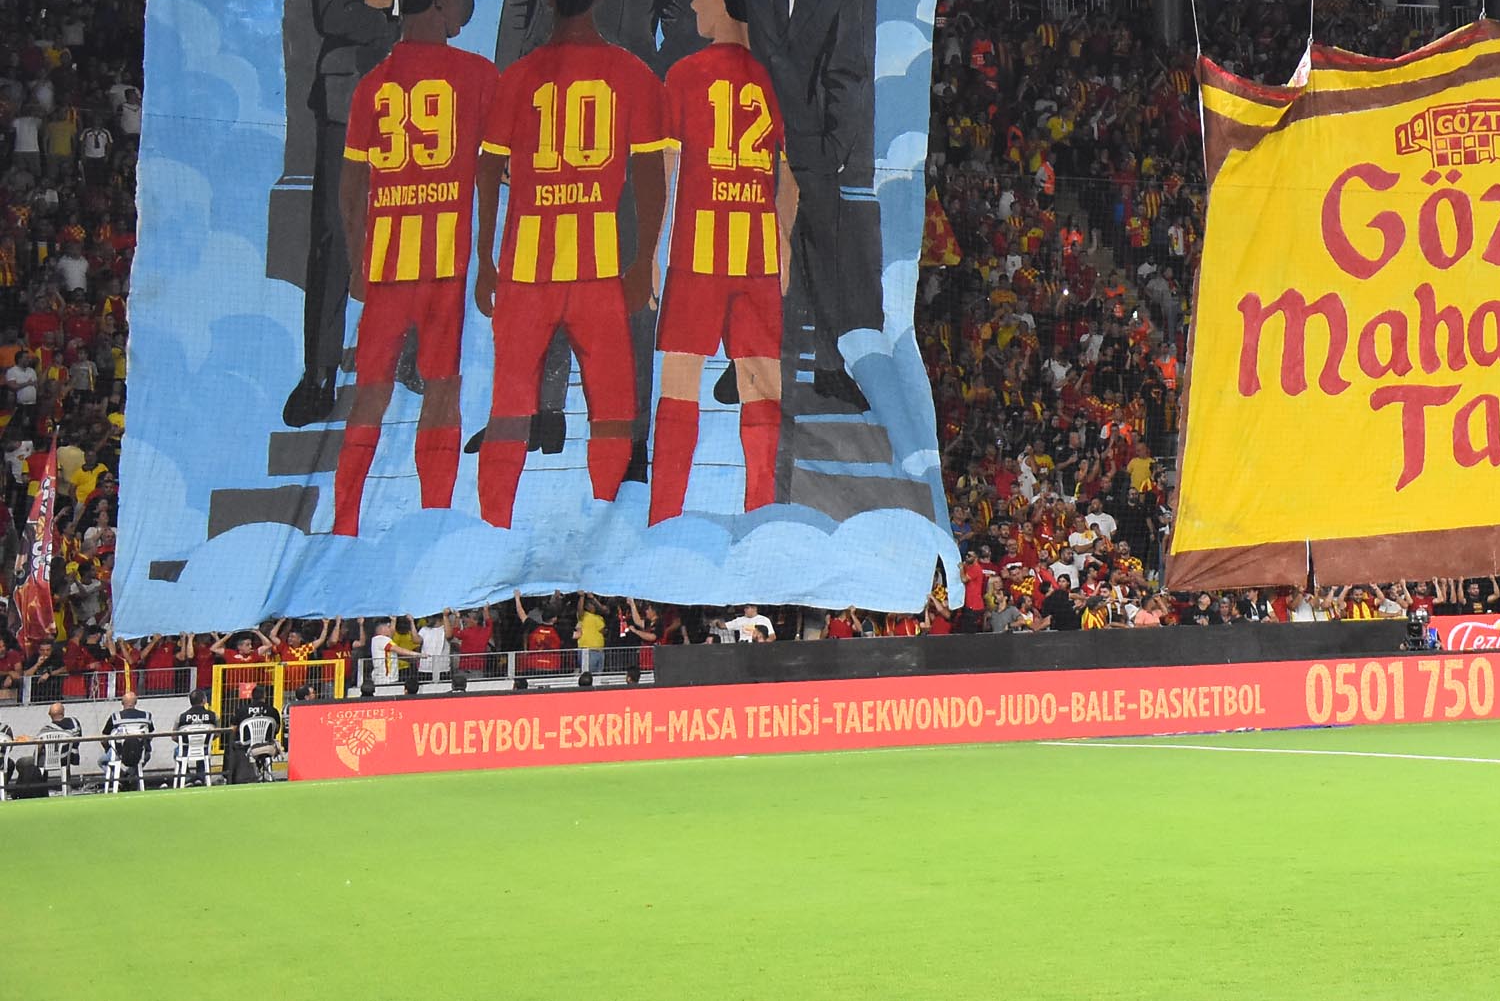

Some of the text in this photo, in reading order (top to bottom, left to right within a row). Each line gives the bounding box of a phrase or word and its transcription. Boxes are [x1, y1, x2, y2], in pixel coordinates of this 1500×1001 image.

[368, 78, 457, 173] 39
[532, 78, 616, 173] 10
[707, 78, 775, 174] 12
[373, 180, 459, 208] JANDERSON
[535, 181, 603, 206] ISHOLA
[712, 177, 766, 204] İSMAİL
[412, 705, 737, 757] VOLEYBOL-ESKRİM-MASA
[1305, 658, 1406, 725] 0501
[1418, 657, 1494, 719] 750
